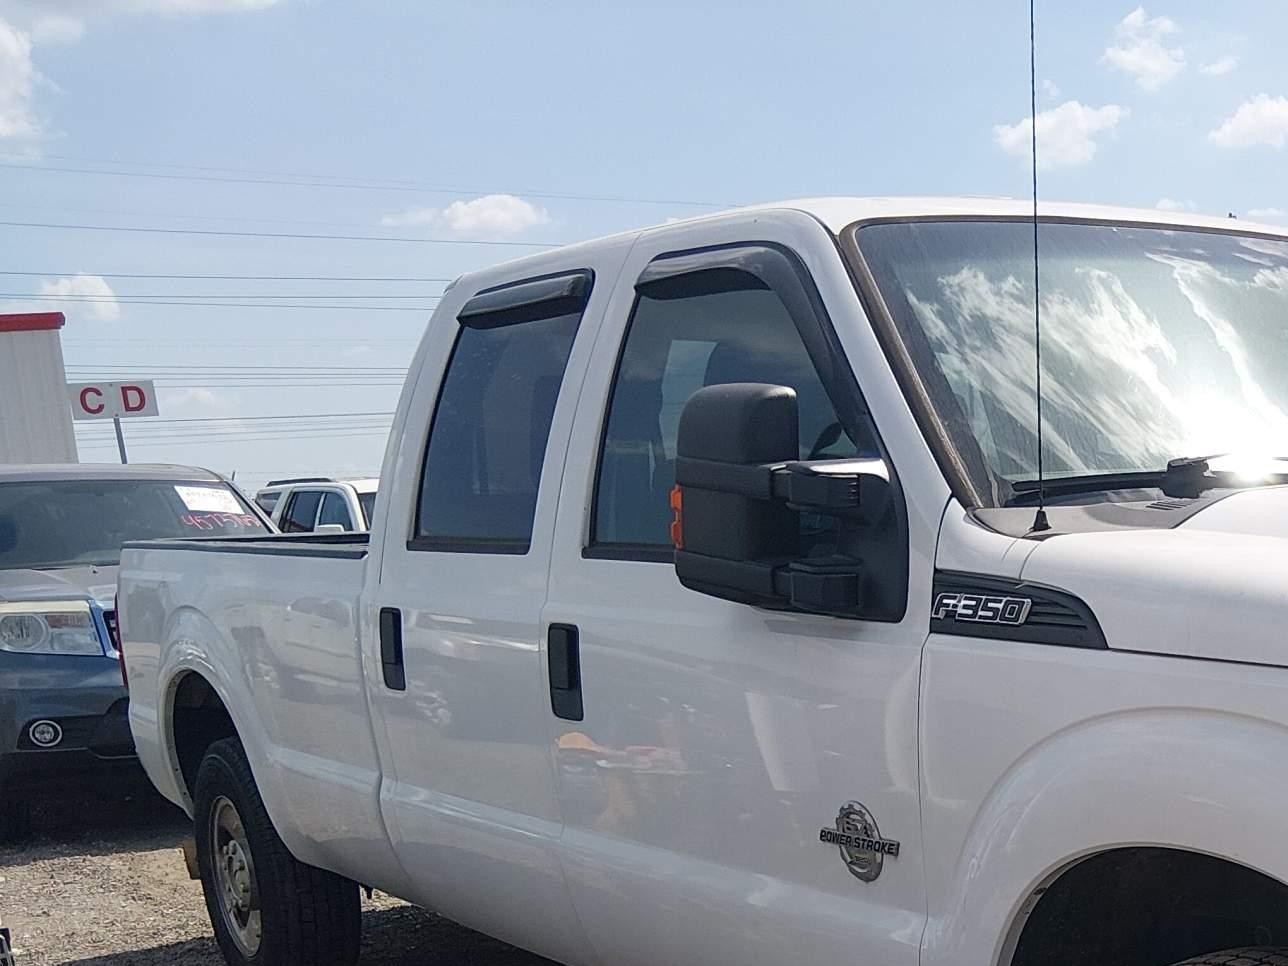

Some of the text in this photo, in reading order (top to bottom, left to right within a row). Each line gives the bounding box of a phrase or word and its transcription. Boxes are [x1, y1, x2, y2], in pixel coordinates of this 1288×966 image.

[79, 385, 146, 415] C D
[931, 593, 1032, 625] F-350
[819, 829, 896, 855] POWER STROKE
